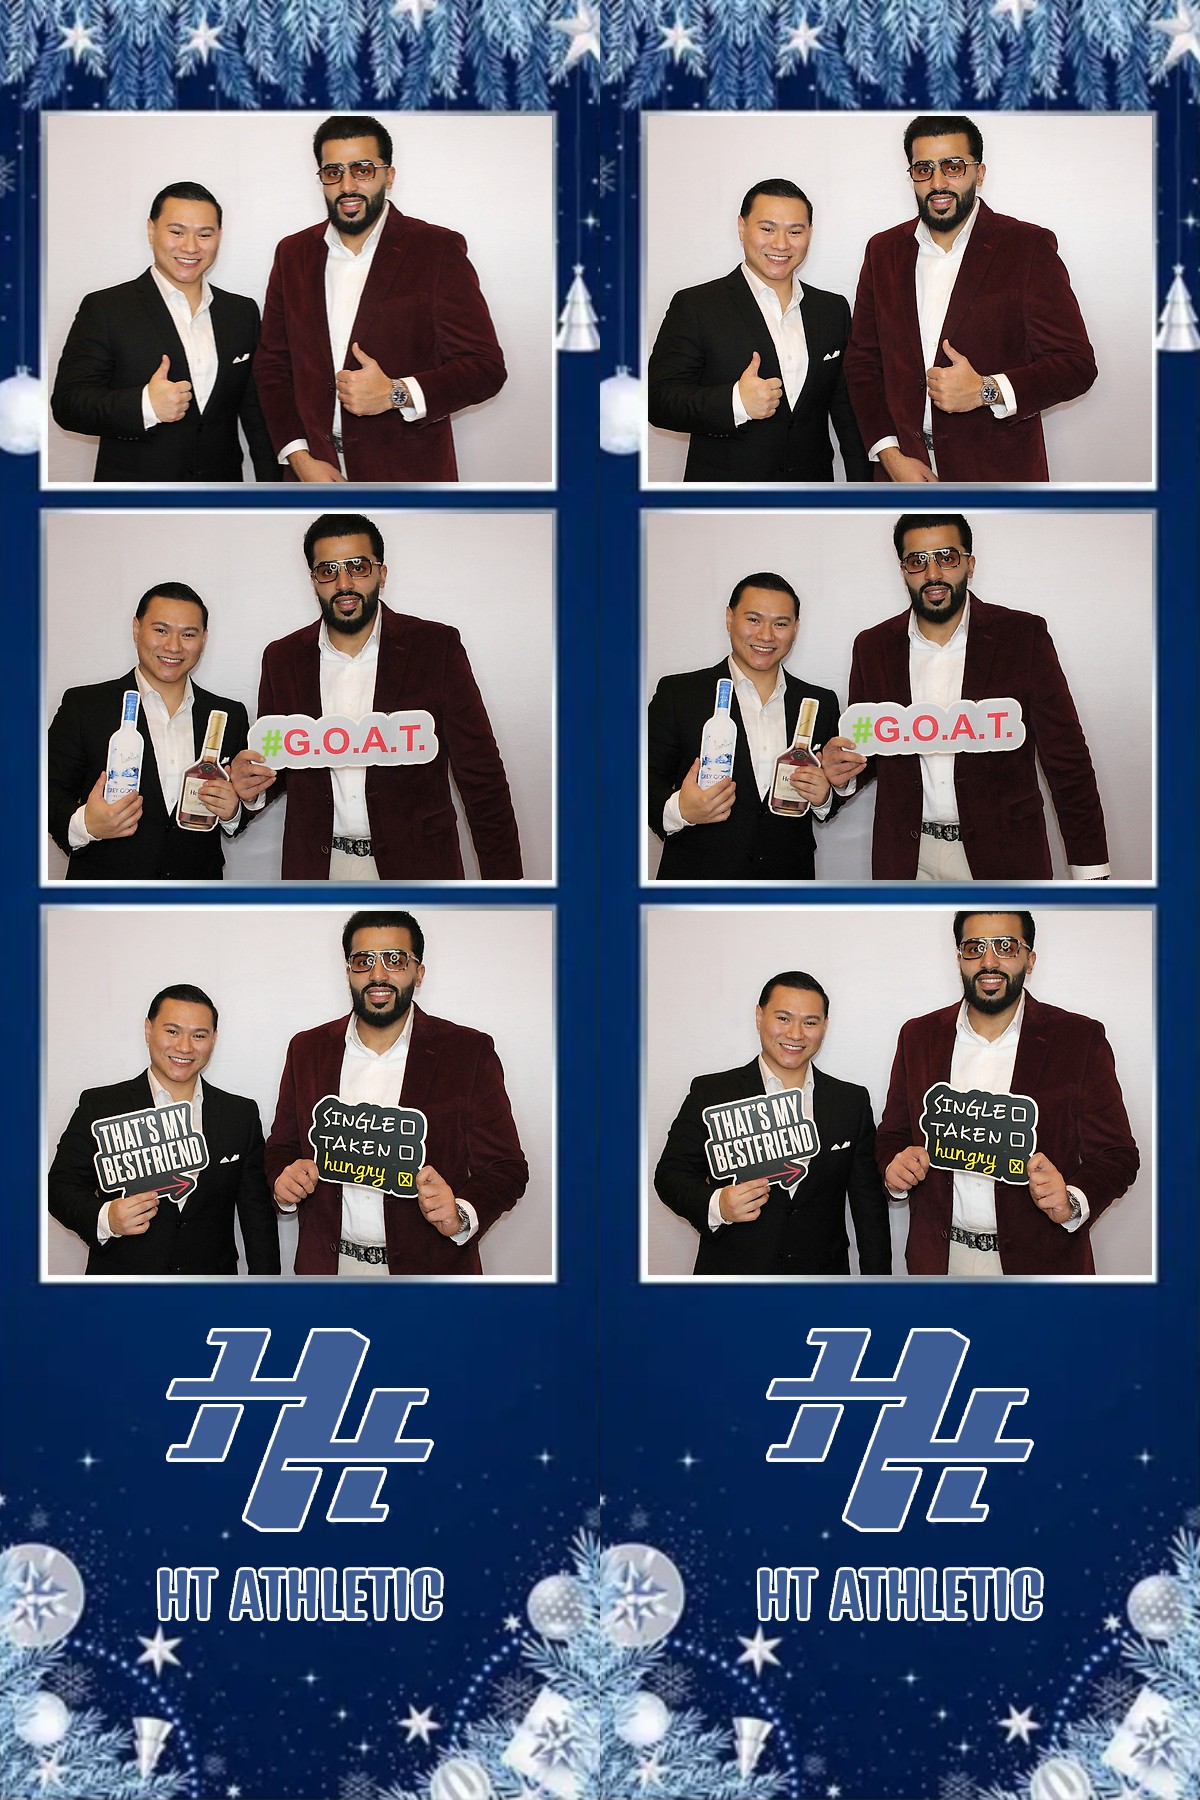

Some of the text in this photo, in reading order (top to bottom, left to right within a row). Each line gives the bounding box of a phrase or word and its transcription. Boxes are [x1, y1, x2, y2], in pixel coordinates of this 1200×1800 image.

[262, 724, 425, 757] #G.O.A.T.
[852, 711, 1012, 744] #G.O.A.T.
[323, 1107, 396, 1133] SINGLE
[710, 1094, 800, 1141] THAT'S MY
[934, 1094, 1007, 1121] SINGLE
[99, 1107, 188, 1154] THAT'S MY
[319, 1135, 391, 1157] TAKEN
[930, 1122, 1002, 1144] TAKEN
[101, 1136, 203, 1186] BESTFRIEND
[712, 1123, 814, 1173] BESTFRIEND
[935, 1139, 997, 1175] hungry
[324, 1152, 386, 1188] hungry
